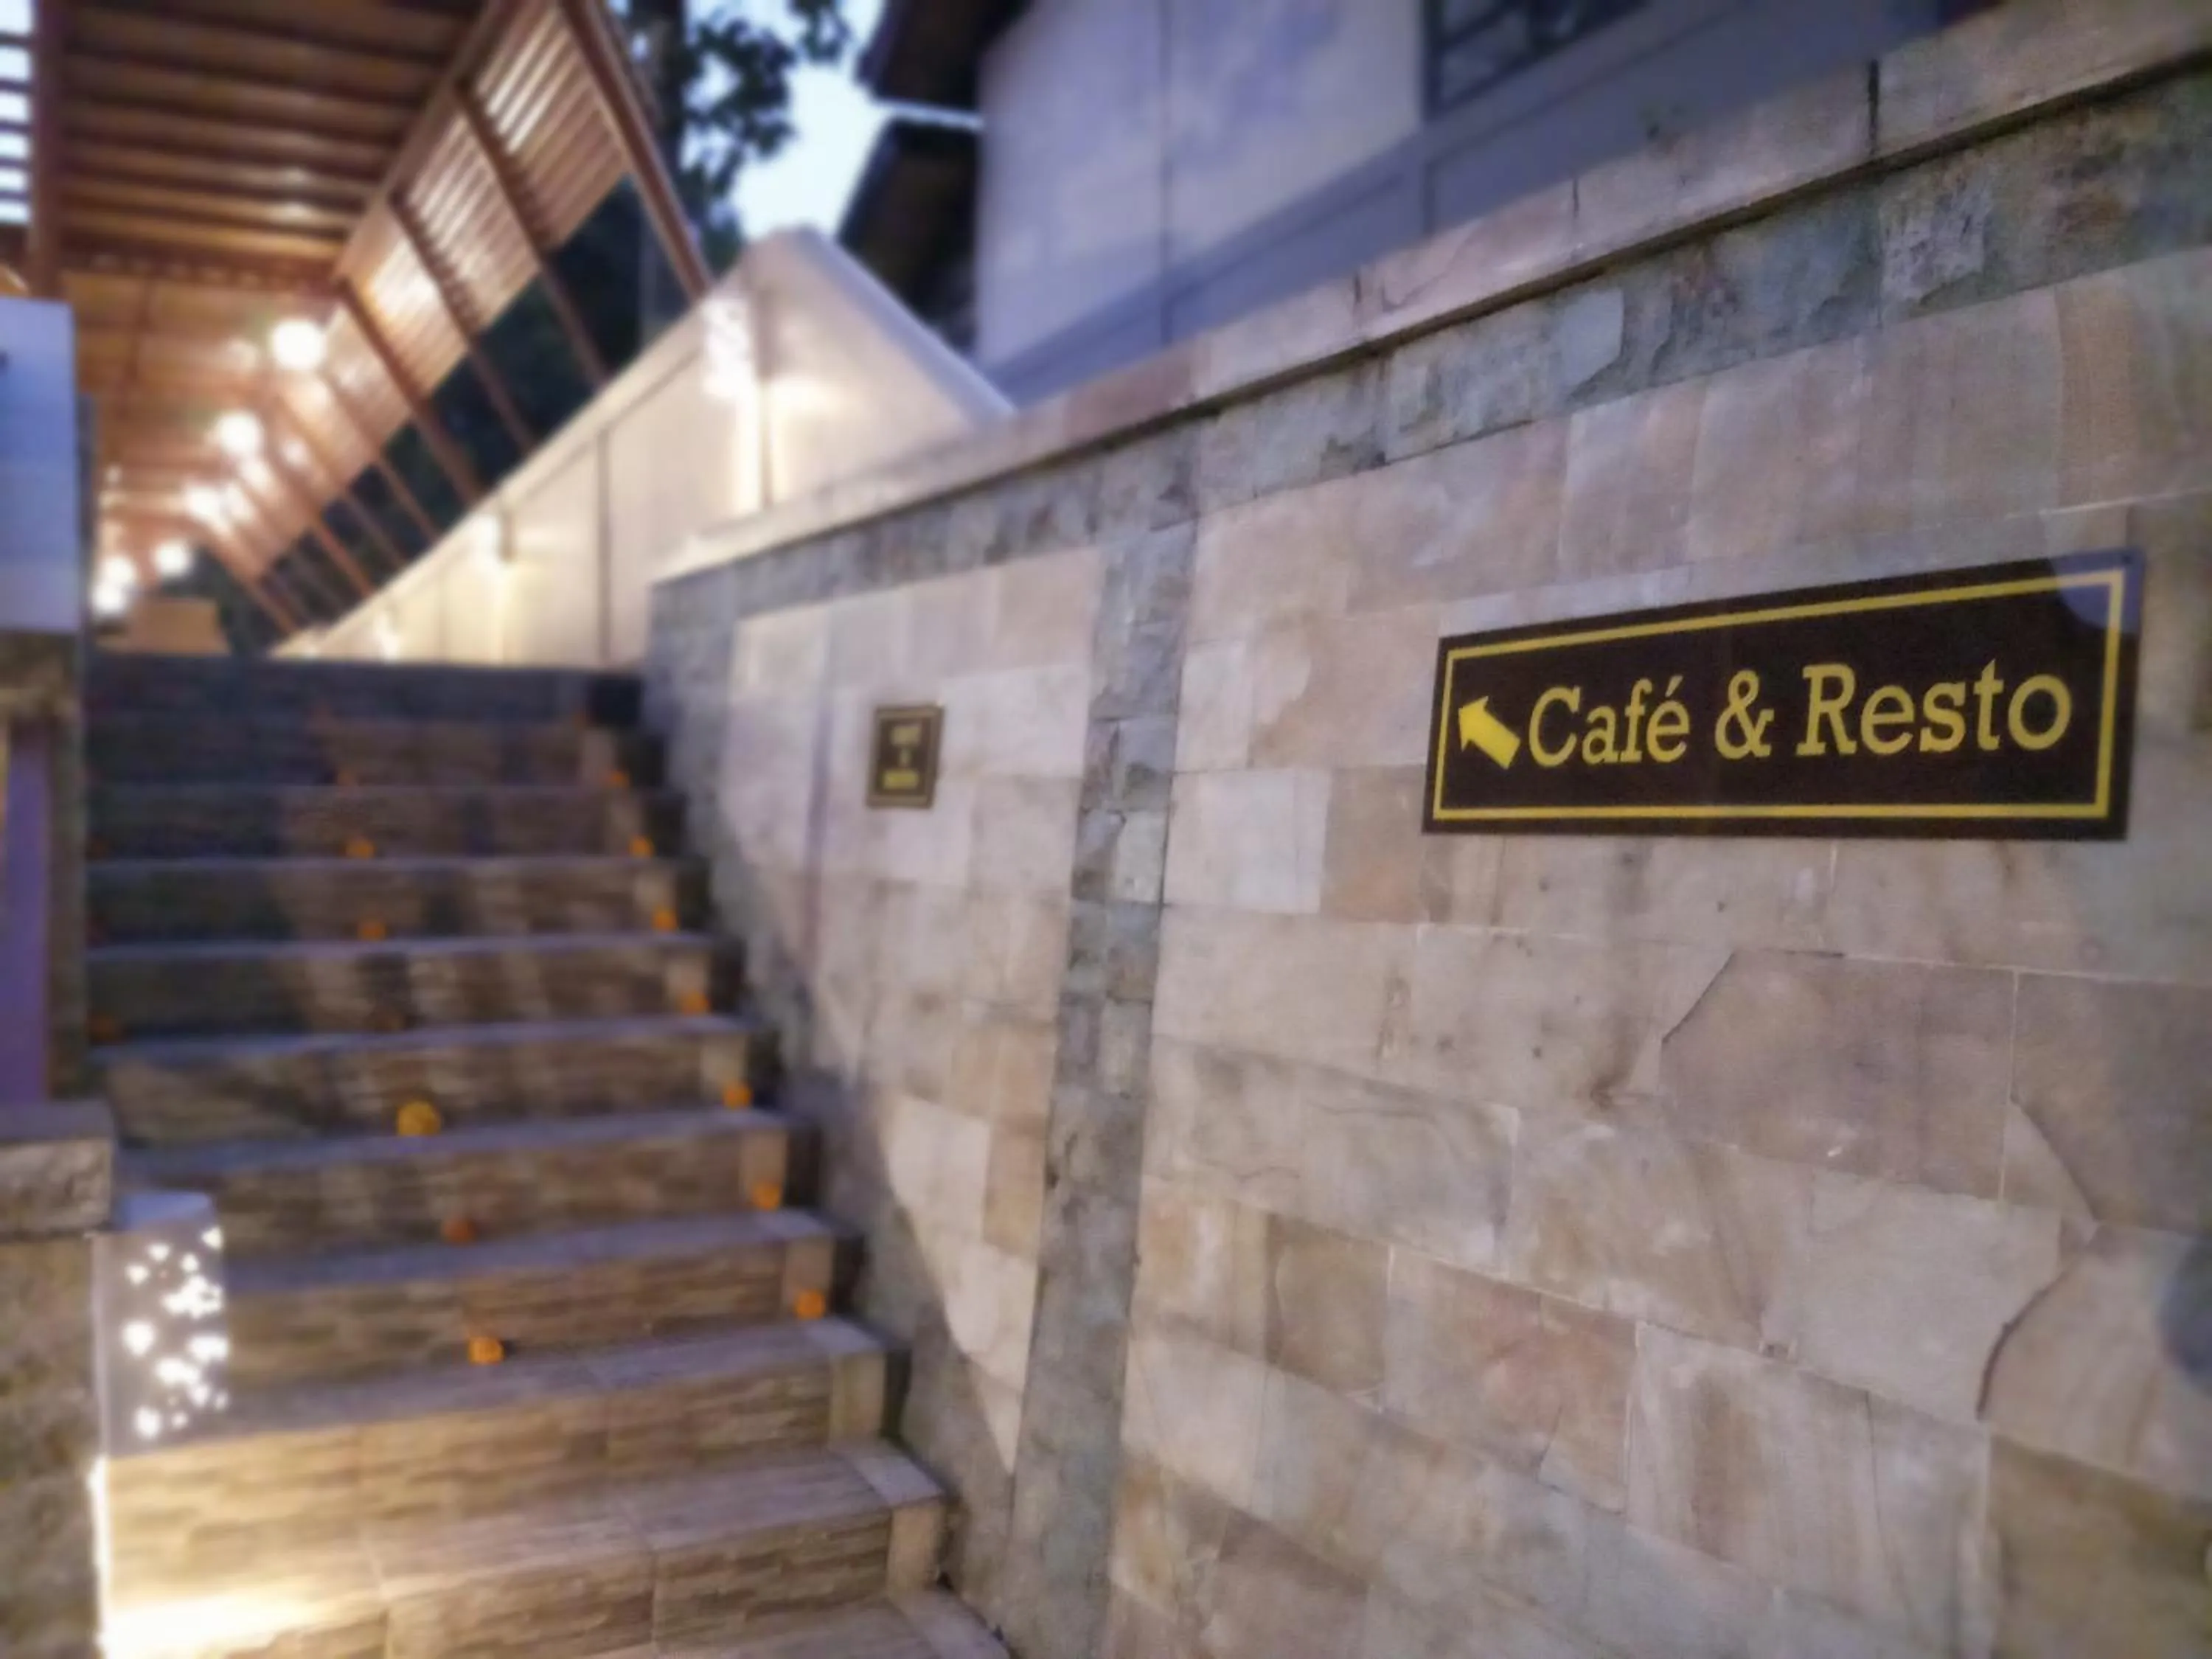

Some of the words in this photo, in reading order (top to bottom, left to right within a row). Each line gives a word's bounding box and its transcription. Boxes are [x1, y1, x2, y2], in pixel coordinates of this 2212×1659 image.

[1528, 675, 1691, 768] Café
[1714, 669, 1775, 761] &
[1795, 658, 2072, 758] Resto
